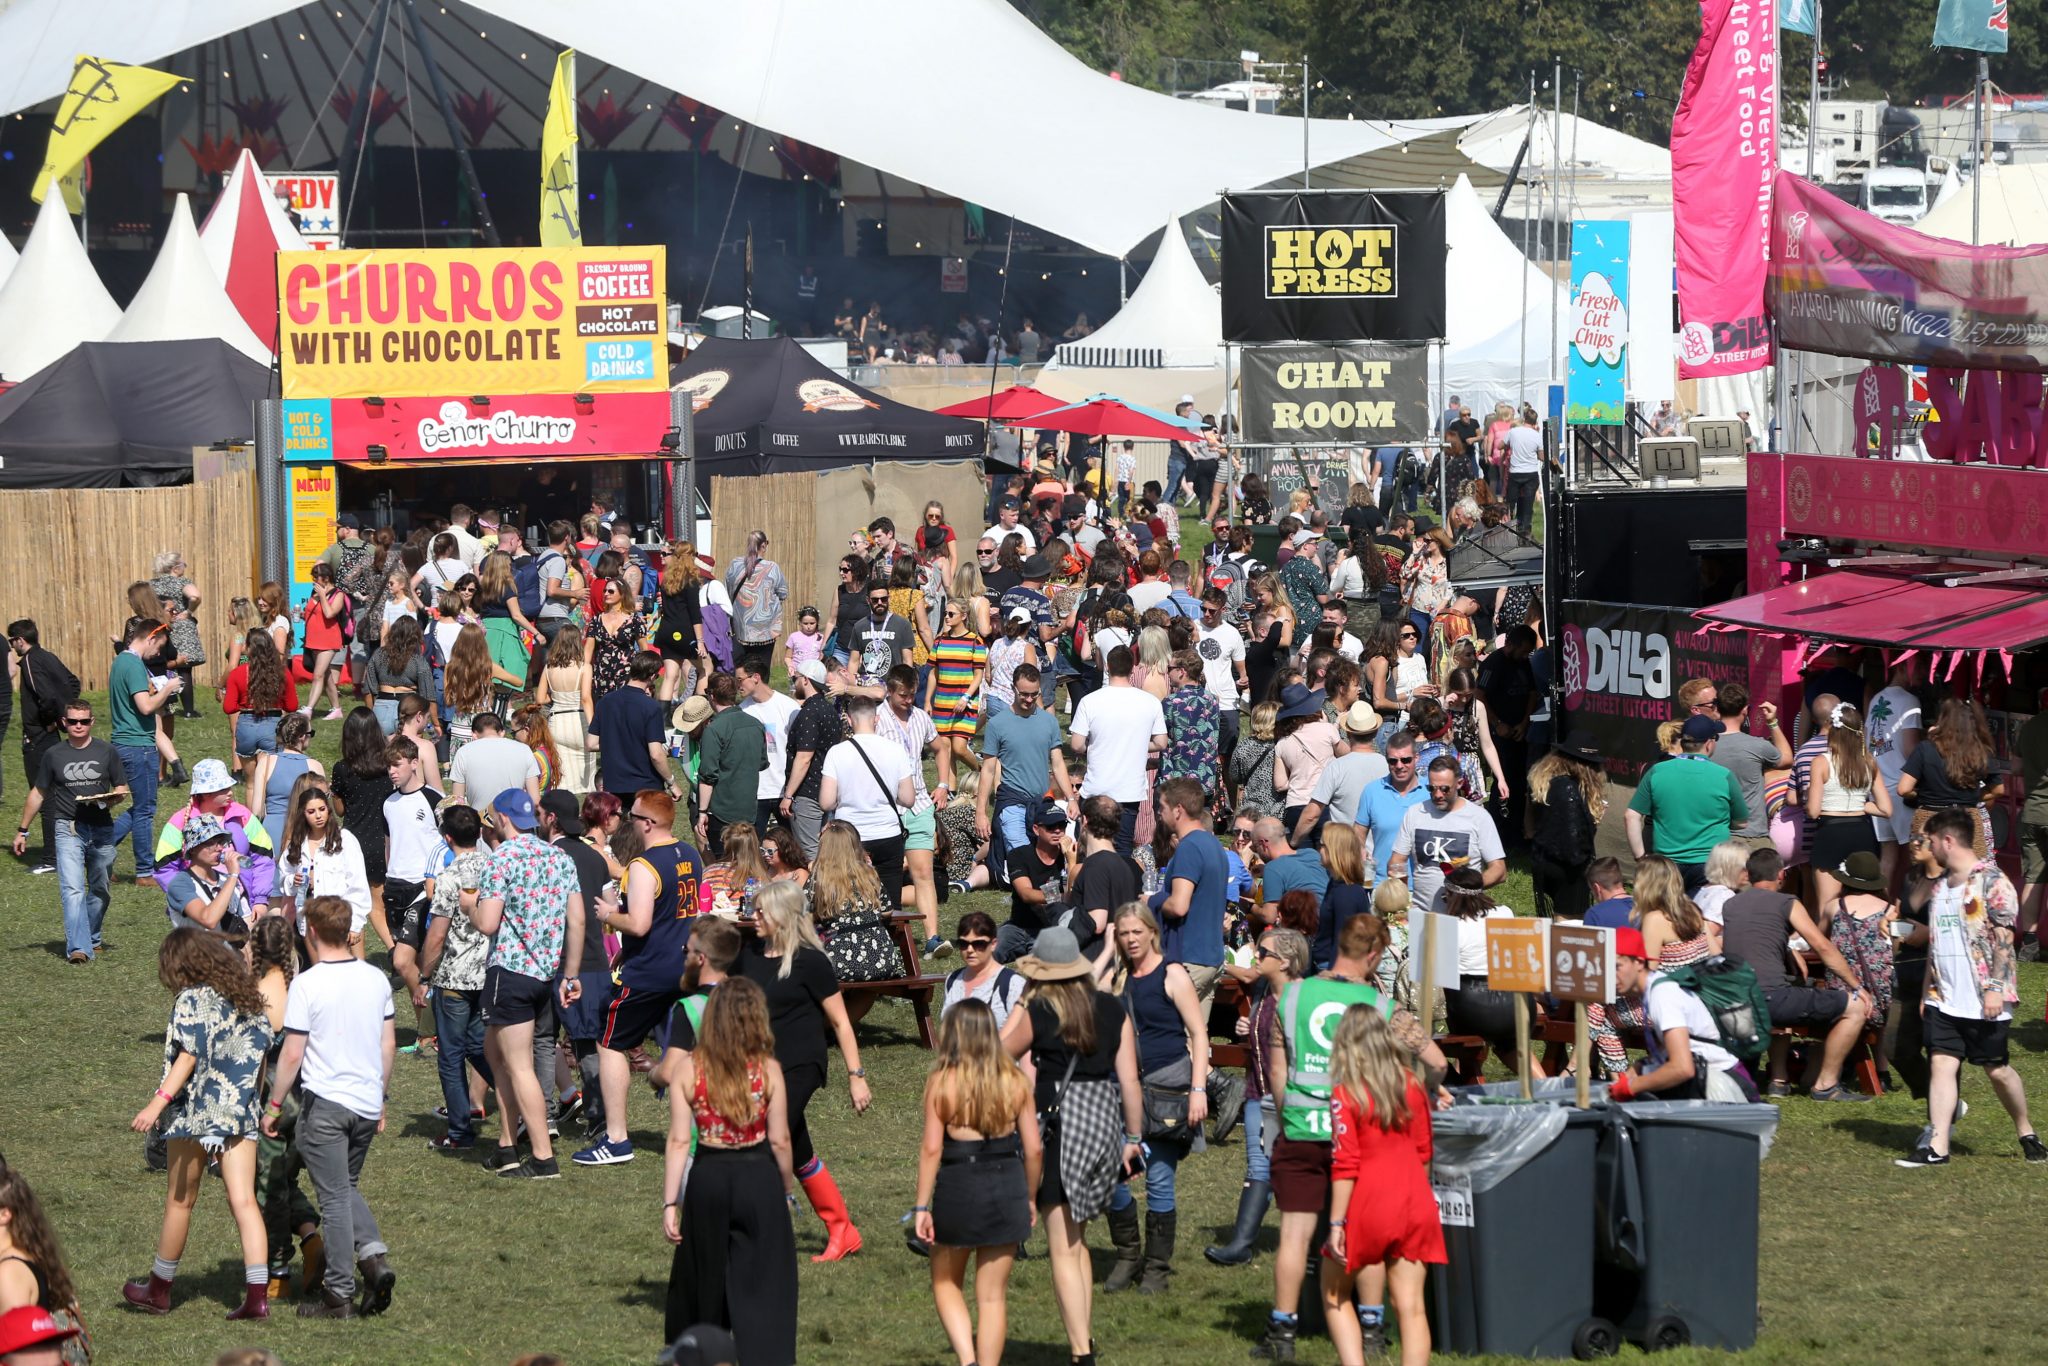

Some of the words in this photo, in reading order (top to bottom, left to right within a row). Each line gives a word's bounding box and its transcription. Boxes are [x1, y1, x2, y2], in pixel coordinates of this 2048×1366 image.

[1730, 0, 1756, 79] treet
[1760, 53, 1773, 73] &
[1738, 85, 1756, 157] Food
[1272, 229, 1392, 268] HOT
[585, 264, 617, 274] FRESHLY
[619, 263, 647, 272] GROUND
[583, 274, 650, 298] COFFEE
[1272, 267, 1392, 293] PRESS
[286, 261, 564, 325] CHURROS
[1579, 291, 1619, 311] Fresh
[602, 308, 633, 320] HOT
[1583, 310, 1611, 328] Cut
[1791, 290, 1900, 332] AWARD-WINNING
[579, 320, 657, 334] CHOCOLATE
[290, 332, 371, 364] WITH
[382, 329, 560, 364] CHOCOLATE
[1575, 327, 1615, 350] Chips
[598, 344, 634, 360] COLD
[1713, 350, 1750, 364] STREET
[591, 360, 644, 377] DRINKS
[1276, 361, 1391, 389] CHAT
[289, 412, 310, 424] HOT
[313, 413, 323, 424] &
[1272, 401, 1396, 428] ROOM
[1922, 366, 2048, 469] SAB
[292, 425, 320, 437] COLD
[495, 415, 571, 439] Churro
[286, 438, 328, 449] DRINKS
[715, 432, 746, 452] DONUTS
[773, 433, 799, 447] COFFEE
[838, 433, 907, 447] WWW.BARISTA.BIKE
[945, 434, 973, 447] DONUTS
[1271, 463, 1320, 477] AMNETY
[296, 479, 331, 492] MENU
[1674, 630, 1710, 652] AWARD
[1712, 634, 1748, 657] WINNIN
[1686, 659, 1747, 685] VIETNAMESE
[1584, 692, 1620, 716] STREET
[1622, 697, 1672, 721] KITCHEN
[676, 878, 699, 919] 23
[1936, 914, 1961, 927] VANS
[1304, 1064, 1324, 1073] the
